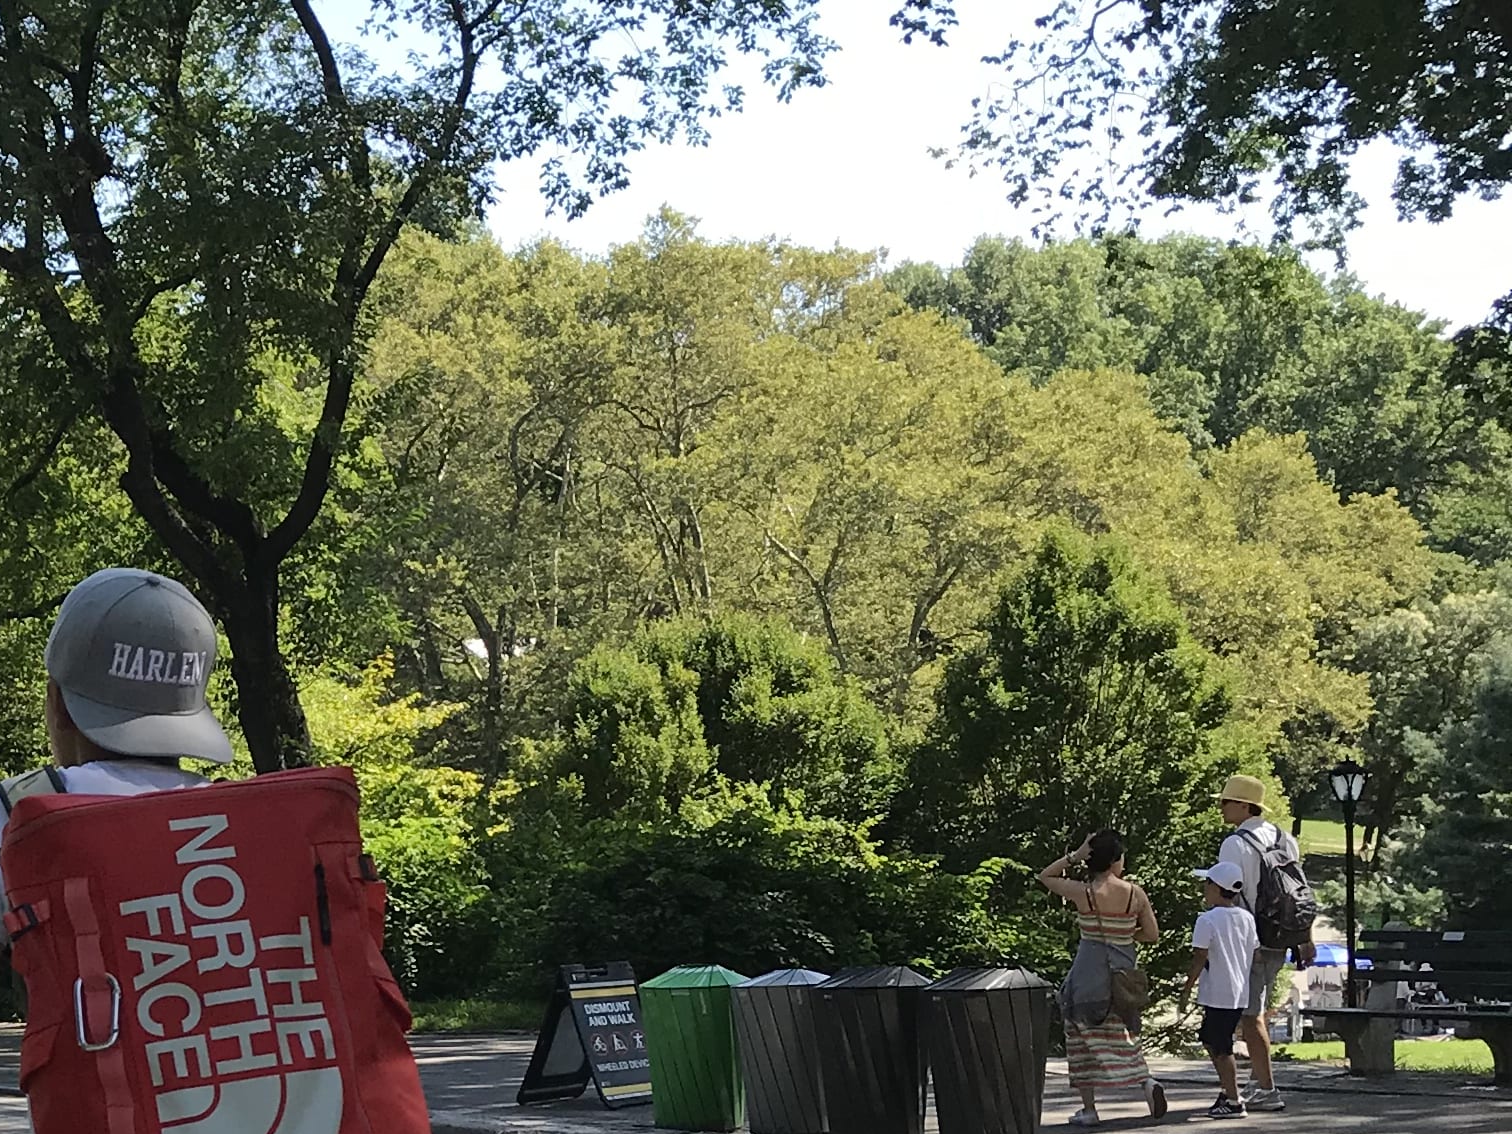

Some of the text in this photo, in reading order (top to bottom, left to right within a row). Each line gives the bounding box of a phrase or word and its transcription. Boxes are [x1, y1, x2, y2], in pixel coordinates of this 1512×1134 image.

[119, 891, 214, 1088] FACE
[169, 813, 281, 1076] NORTH
[259, 916, 338, 1067] THE
[584, 1001, 630, 1014] DISMOUNT
[588, 1012, 636, 1027] AND WALK
